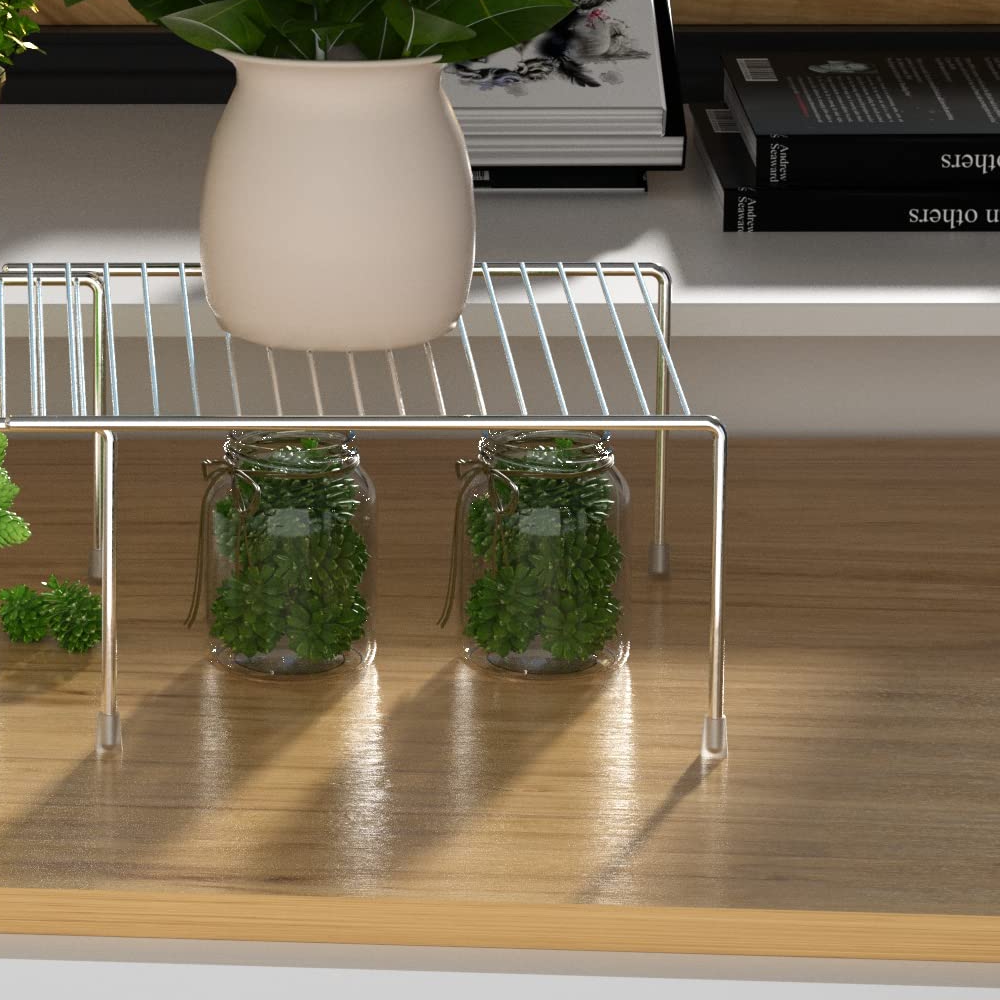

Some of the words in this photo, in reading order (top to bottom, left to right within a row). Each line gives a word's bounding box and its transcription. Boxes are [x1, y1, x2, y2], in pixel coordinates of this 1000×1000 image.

[769, 143, 780, 183] Seaward
[779, 144, 789, 181] Andrew
[941, 153, 1000, 174] thers
[908, 208, 978, 229] others
